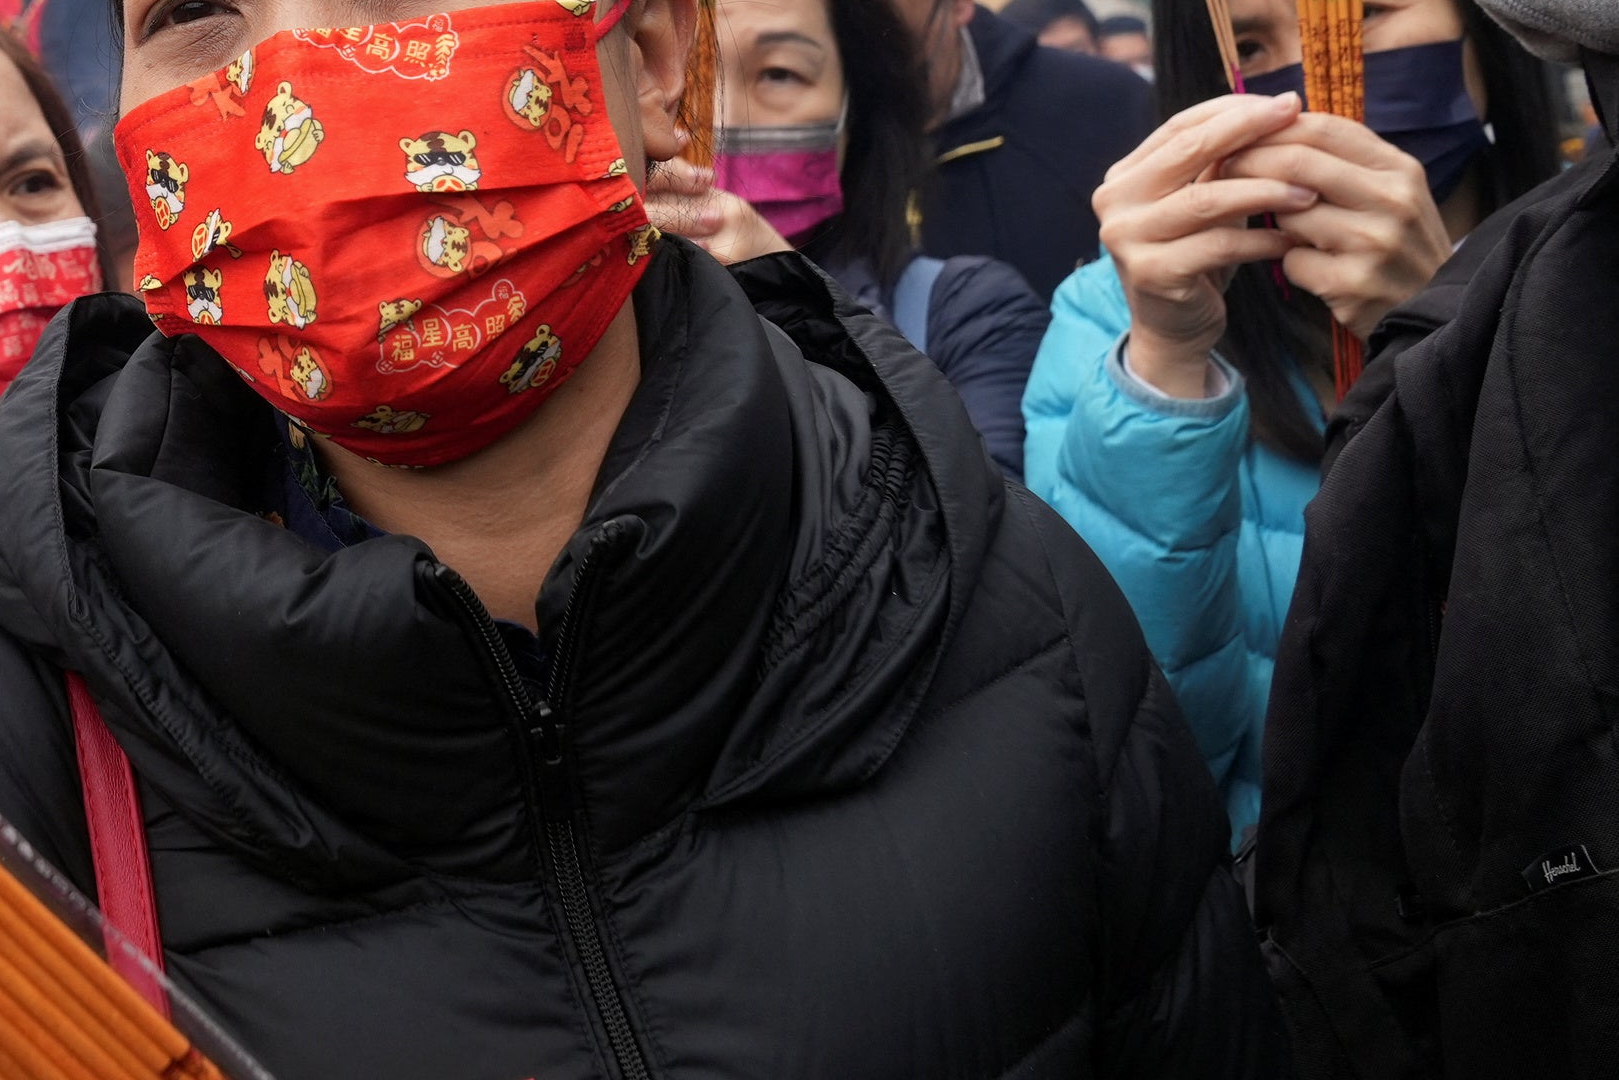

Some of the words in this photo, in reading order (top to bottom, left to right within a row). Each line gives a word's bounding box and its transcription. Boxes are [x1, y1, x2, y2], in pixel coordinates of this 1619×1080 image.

[391, 314, 505, 361] 福星高照
[1541, 851, 1582, 884] Herschel
